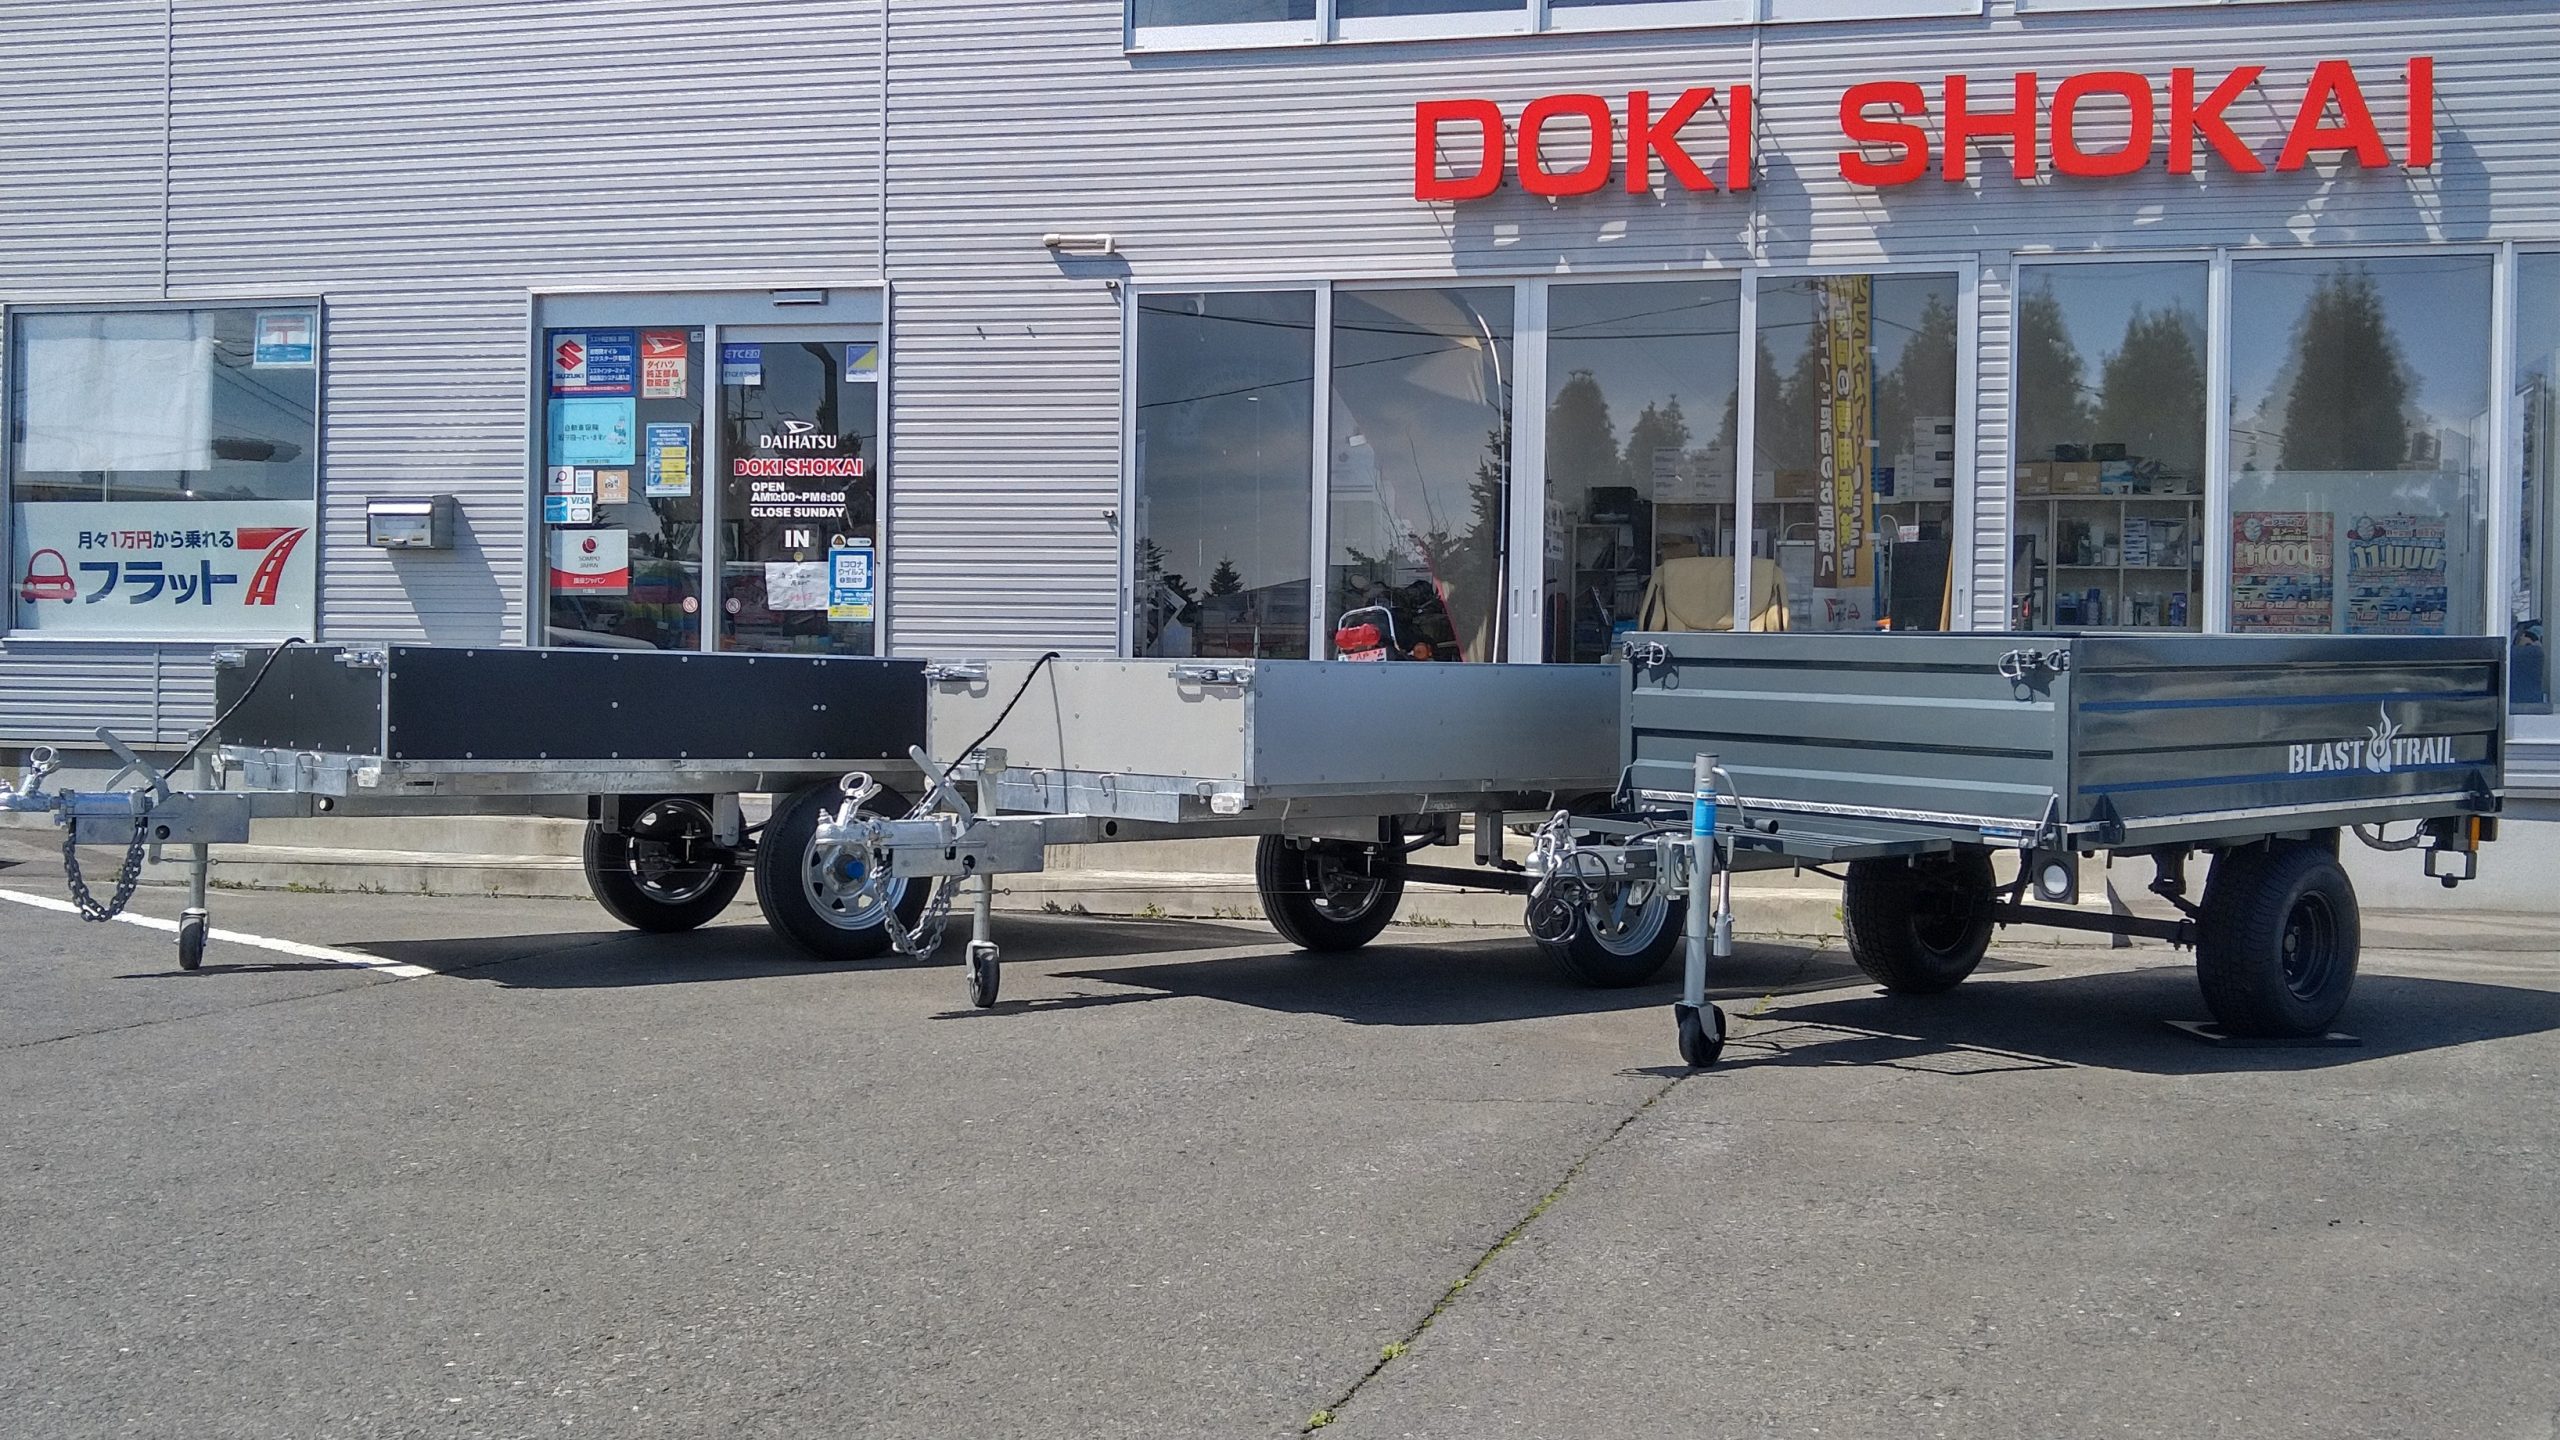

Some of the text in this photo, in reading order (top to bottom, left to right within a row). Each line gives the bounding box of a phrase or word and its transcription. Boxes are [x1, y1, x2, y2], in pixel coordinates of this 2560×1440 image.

[1415, 57, 2433, 200] DOKI SHOKAI
[646, 369, 679, 377] 純正部品
[760, 435, 837, 449] DAIHATSU
[733, 458, 864, 477] DOKI SHOKAI
[751, 482, 785, 492] OPEN
[571, 497, 590, 505] VISA
[751, 507, 845, 517] CLOSE SUNDAY
[78, 530, 234, 550] 月々1万円から乗れる
[785, 530, 810, 548] IN
[2288, 736, 2456, 773] BLAST TRAIL
